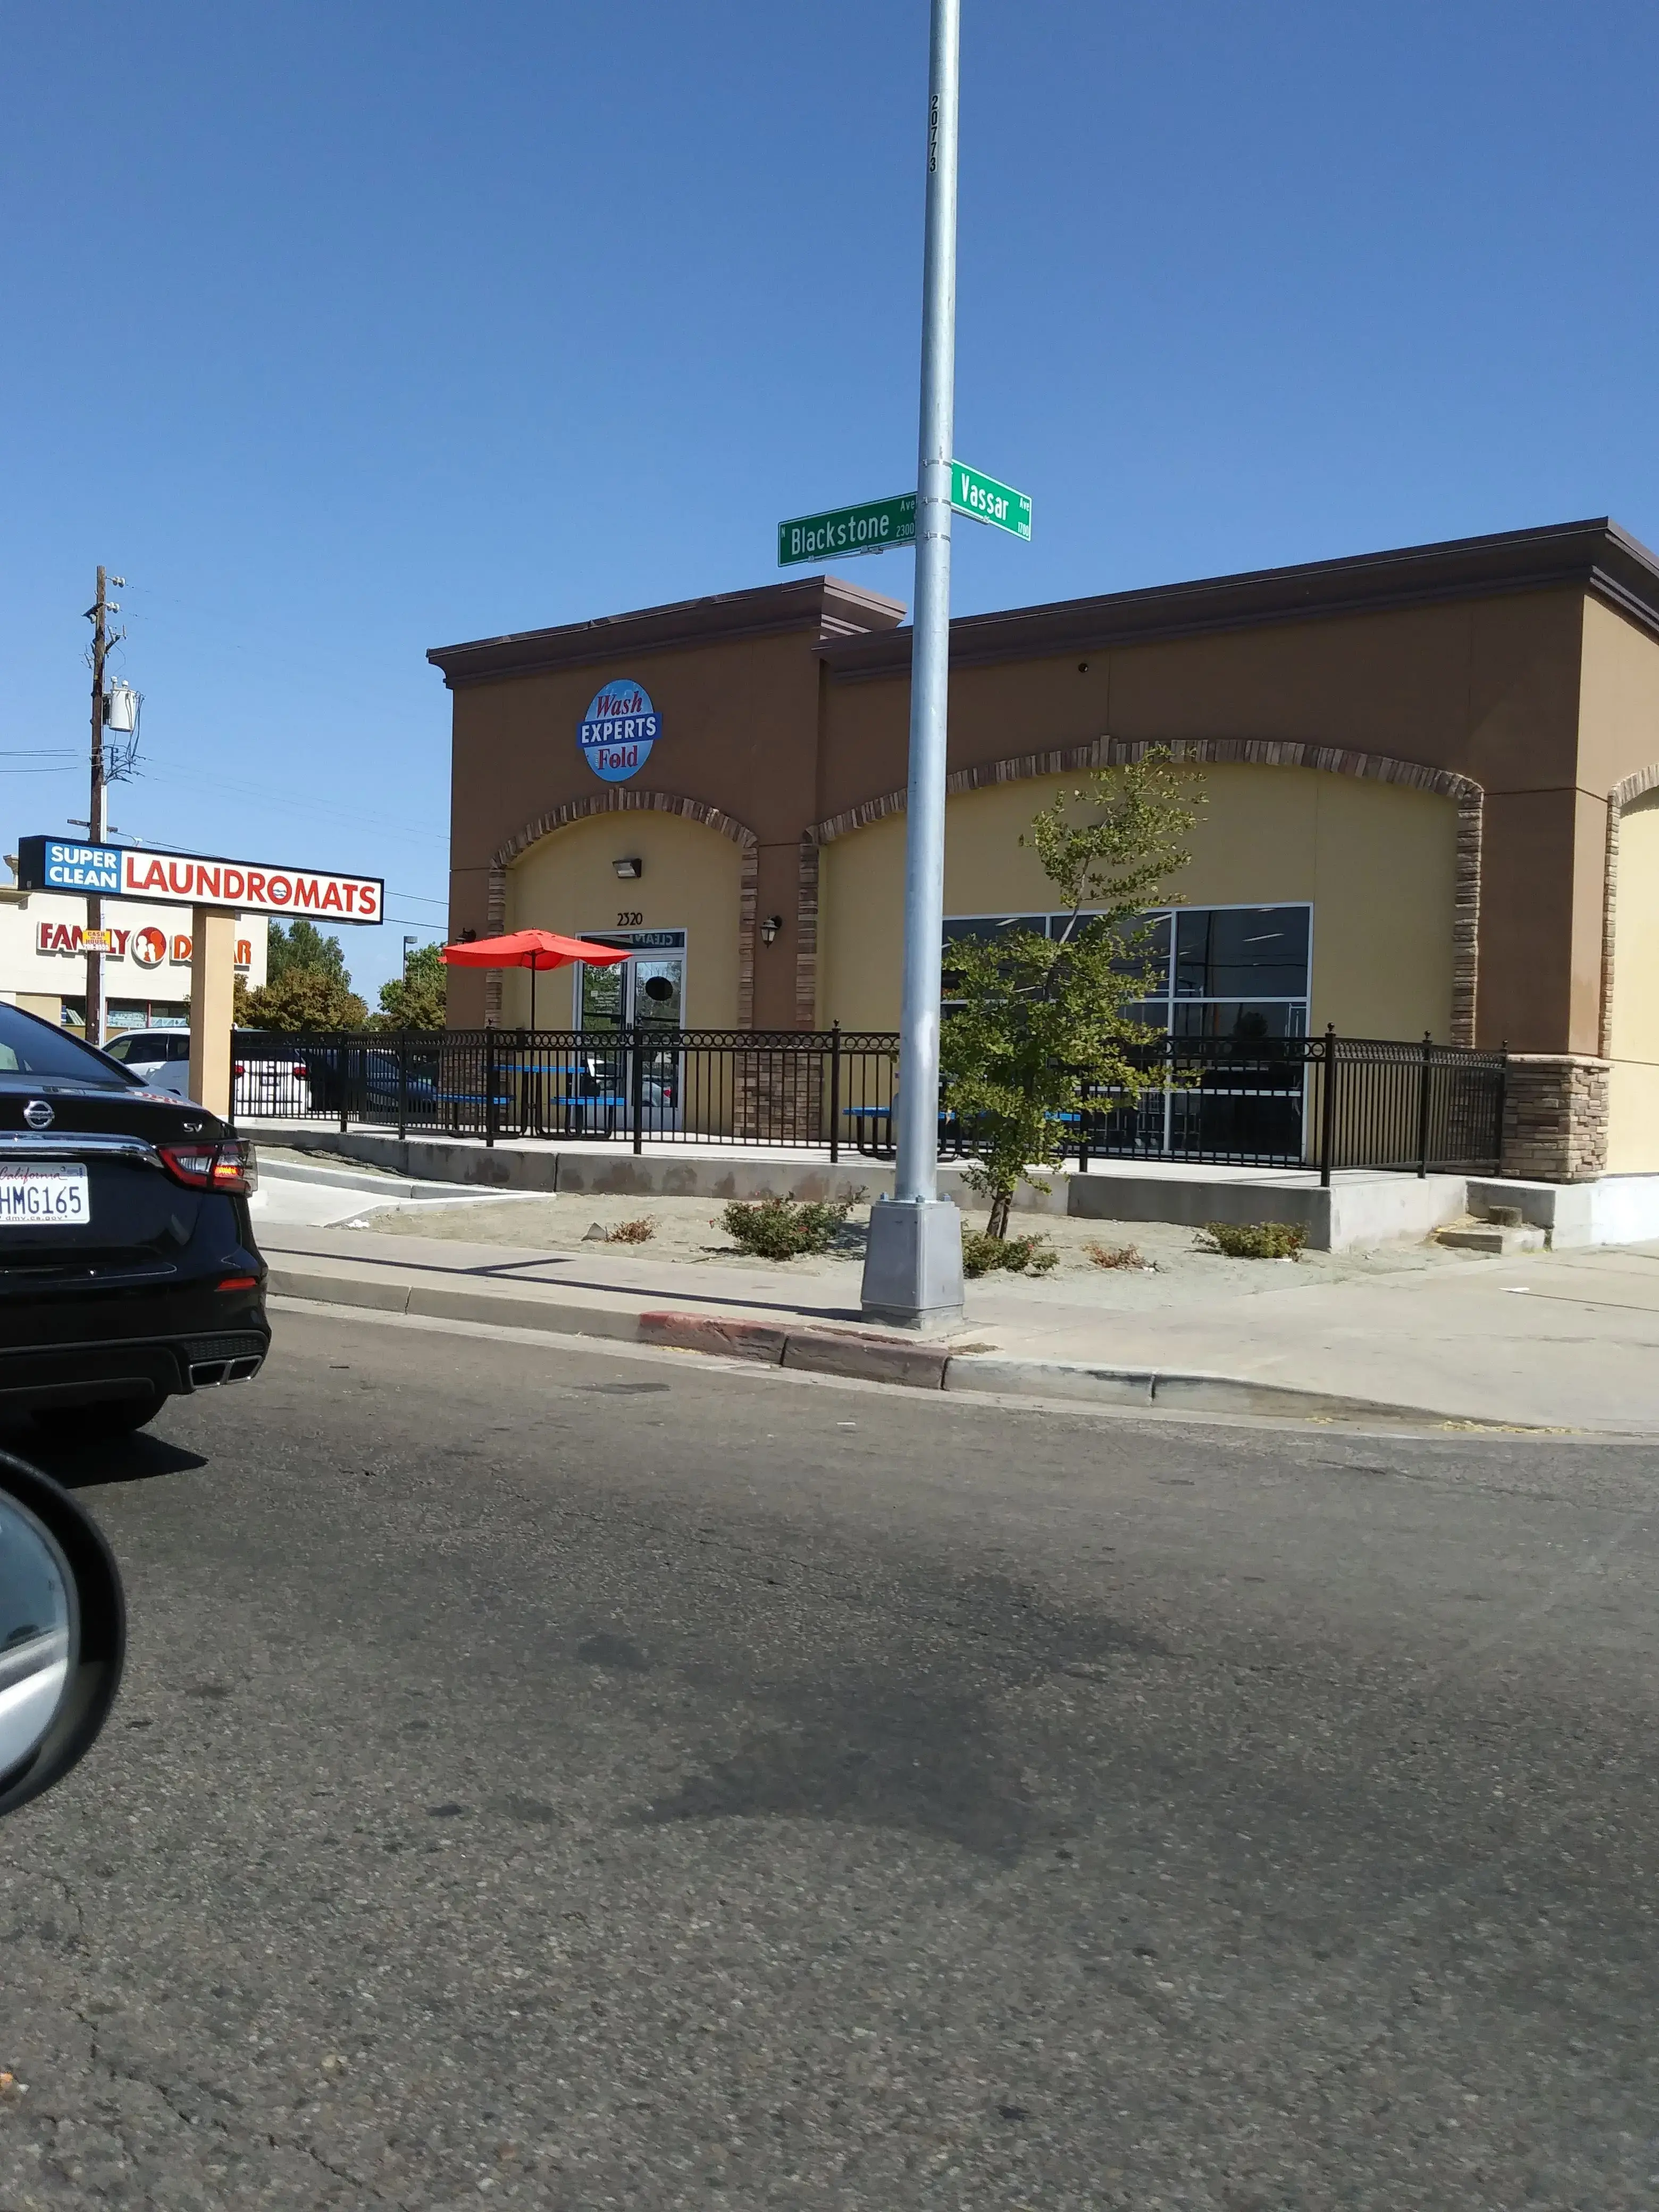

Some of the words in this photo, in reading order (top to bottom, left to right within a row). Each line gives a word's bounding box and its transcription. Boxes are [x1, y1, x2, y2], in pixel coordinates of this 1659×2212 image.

[929, 95, 938, 172] 20773
[961, 473, 1009, 521] Vassar
[1019, 497, 1029, 512] Ave
[781, 526, 785, 538] N
[791, 514, 890, 555] Blackstone
[900, 500, 915, 512] Ave
[896, 522, 915, 537] 2300
[1018, 522, 1029, 537] 1700
[597, 691, 642, 718] Wash
[581, 716, 656, 743] EXPERTS
[598, 745, 638, 770] Fold
[51, 846, 117, 869] SUPER
[49, 866, 117, 889] CLEAN
[127, 857, 376, 915] LAUNDROMATS
[617, 912, 643, 926] 2320
[183, 1122, 203, 1133] SV
[0, 1166, 68, 1184] California
